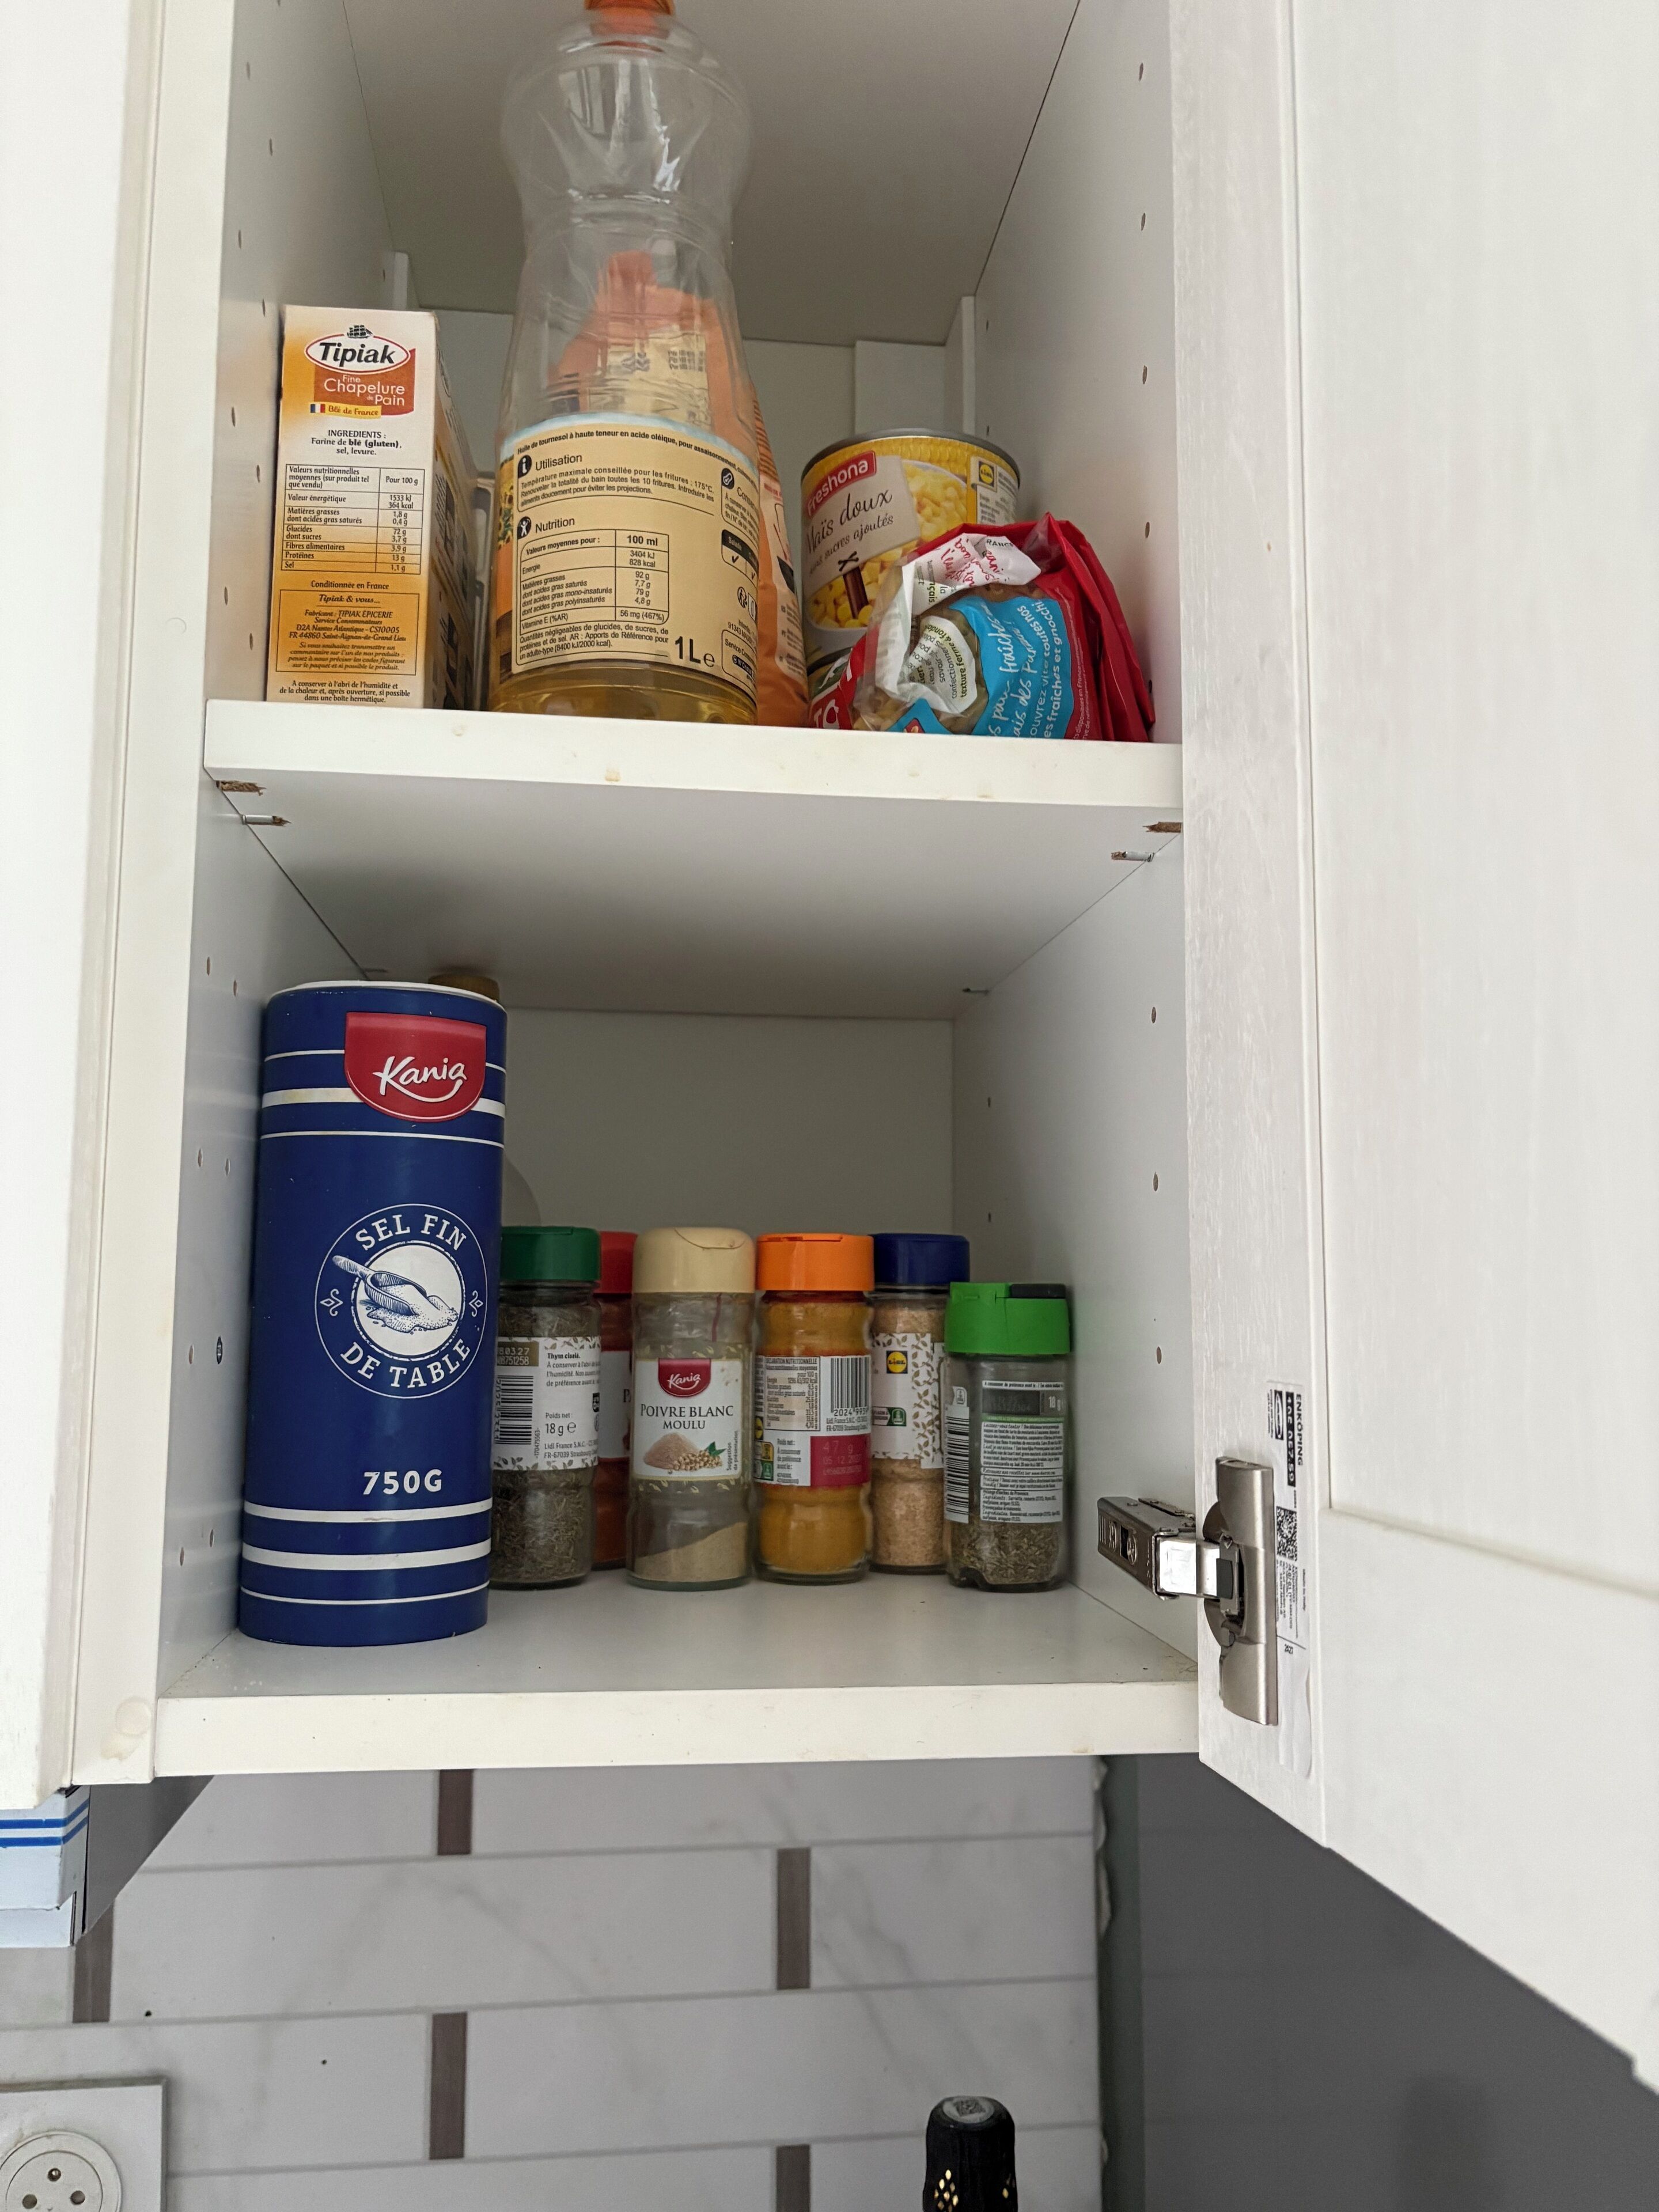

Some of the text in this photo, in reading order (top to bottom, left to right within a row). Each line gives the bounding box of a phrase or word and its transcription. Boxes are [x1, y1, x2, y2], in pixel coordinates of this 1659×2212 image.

[319, 342, 395, 367] Tipiak
[343, 375, 361, 383] Fine
[324, 378, 404, 396] Chapelure
[375, 395, 404, 406] Pain
[539, 433, 568, 446] tournesol
[630, 430, 650, 440] acide
[679, 439, 692, 449] pour
[351, 448, 377, 456] levure.
[536, 454, 582, 471] Utilisation
[289, 466, 359, 475] Valeurs nutritionnelles
[302, 481, 323, 489] vendu)
[336, 475, 360, 483] produit
[521, 474, 557, 490] Température
[559, 468, 592, 478] maximale
[652, 470, 663, 478] les
[664, 471, 689, 484] fritures
[573, 486, 586, 494] pour
[617, 484, 652, 494] projections.
[652, 478, 676, 490] fritures.
[678, 484, 705, 499] Introduire
[807, 459, 869, 514] Freshona
[309, 494, 346, 503] énergétique
[840, 490, 893, 527] doux
[286, 525, 312, 533] Glucides
[535, 517, 575, 533] Nutrition
[627, 535, 658, 546] 100 ml
[825, 513, 893, 559] sucres ajoutés
[306, 543, 345, 551] alimentaires
[547, 536, 596, 550] moyennes pour
[285, 551, 314, 559] Protéines
[630, 550, 646, 558] 3404
[635, 571, 644, 579] 92
[366, 582, 389, 590] France
[565, 586, 612, 597] mono-insaturés
[319, 594, 344, 602] Tipiak
[642, 611, 665, 623] (467%)
[1017, 605, 1033, 622] nos
[987, 618, 1018, 673] fraîches
[1032, 622, 1050, 657] toutes
[949, 643, 964, 666] ferme
[1032, 601, 1062, 721] fraîches et gnocchi
[328, 688, 344, 696] après
[350, 695, 385, 703] hermétique.
[372, 1056, 467, 1103] Kania
[355, 1213, 467, 1252] SEL FIN
[340, 1339, 471, 1389] DE TABLE
[667, 1372, 701, 1390] Kania
[1048, 1396, 1061, 1411] 18 g
[641, 1404, 734, 1417] POIVRE BLANC
[545, 1423, 564, 1436] 18 g
[663, 1421, 706, 1429] MOULU
[1296, 1393, 1304, 1466] ENKÖPING
[362, 1469, 443, 1495] 750G
